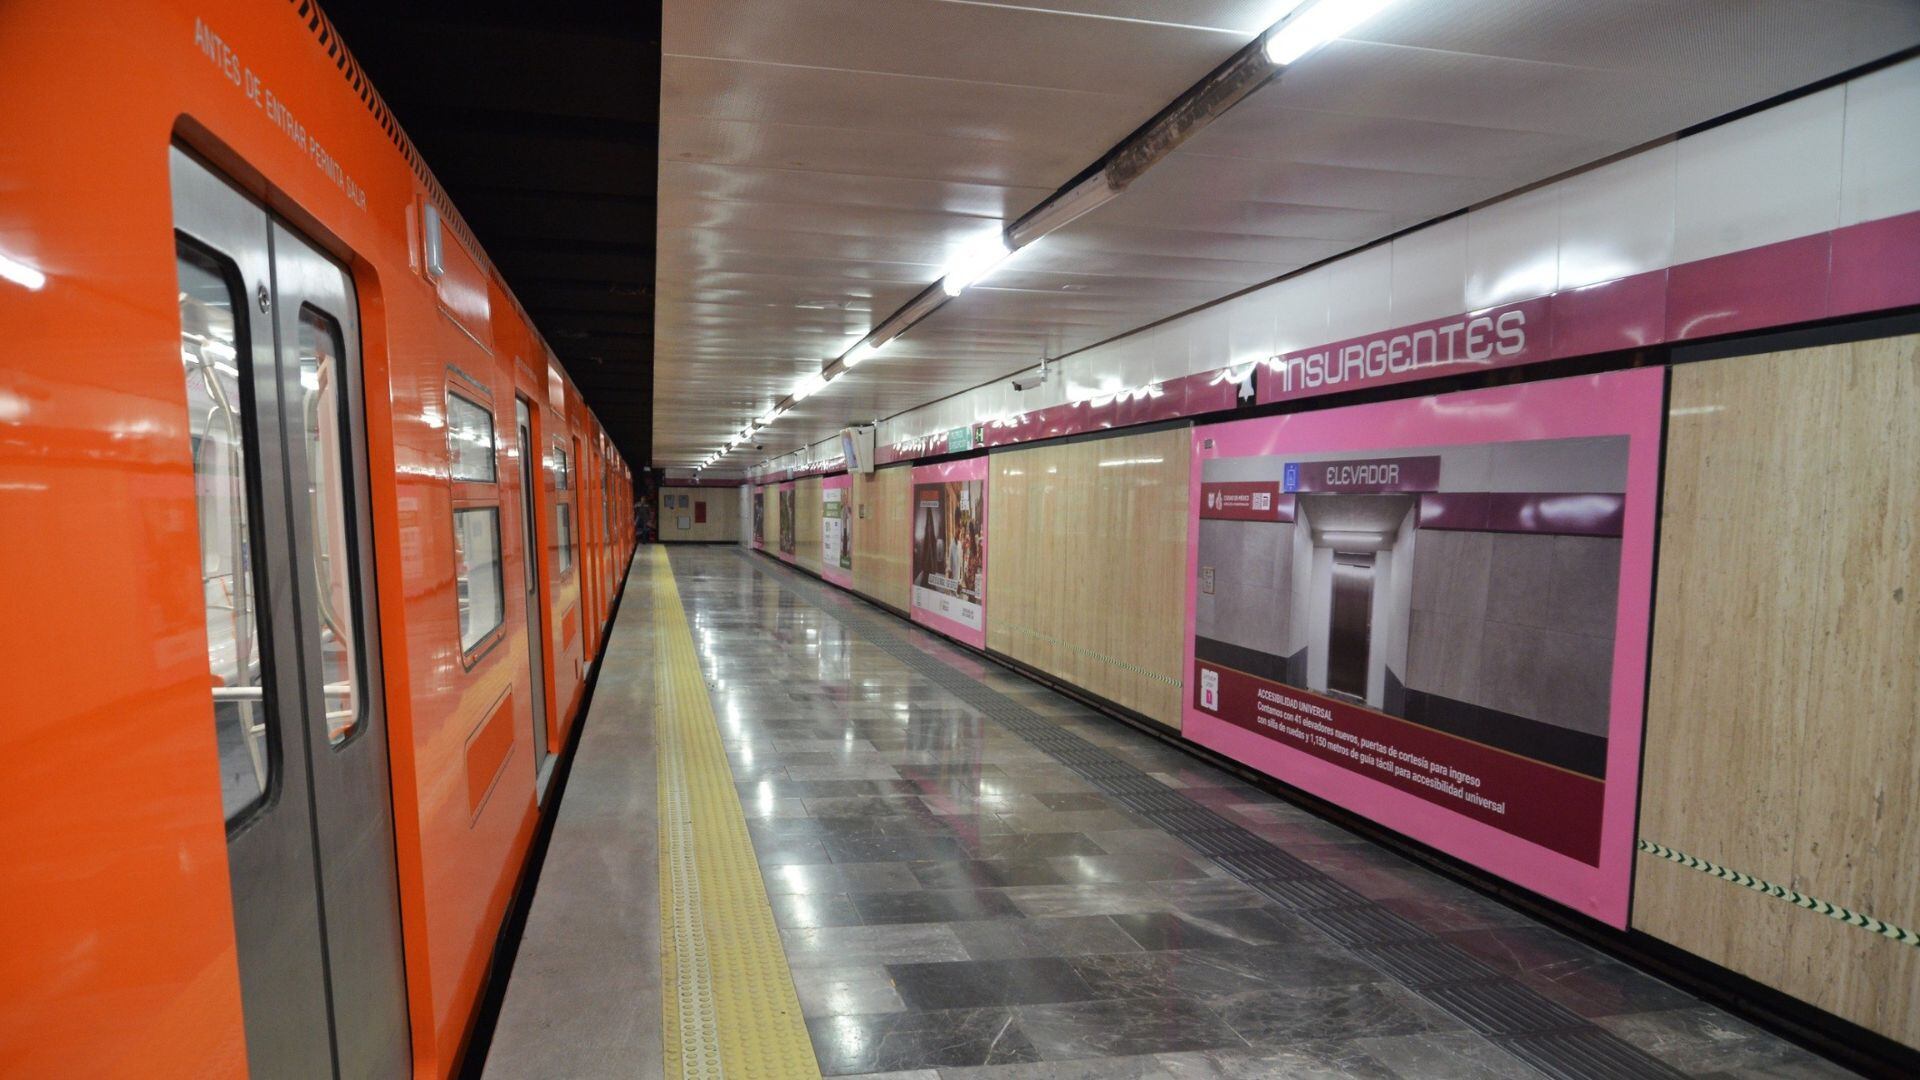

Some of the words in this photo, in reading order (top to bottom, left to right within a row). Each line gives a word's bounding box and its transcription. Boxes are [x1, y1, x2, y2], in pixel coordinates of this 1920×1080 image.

[194, 16, 241, 86] ANTES
[244, 66, 263, 110] DE
[265, 89, 307, 152] ENTRAR
[309, 135, 344, 190] PERMITA
[346, 175, 368, 213] SALIR
[1282, 310, 1526, 392] INSURGENTES
[1326, 464, 1399, 486] ELEVADOR
[1258, 688, 1298, 709] ACCESIBILIDAD
[1298, 701, 1333, 721] UNIVERSAL
[1258, 701, 1283, 717] Contamos
[1283, 710, 1294, 721] con
[1294, 714, 1302, 723] 41
[1302, 717, 1334, 736] elevadores
[1335, 729, 1360, 746] nuevos,
[1360, 738, 1387, 754] puertas
[1388, 745, 1398, 757] de
[1398, 750, 1429, 769] cortesía
[1430, 761, 1447, 776] para
[1450, 766, 1481, 787] ingreso
[1258, 715, 1267, 725] con
[1267, 718, 1278, 730] silla
[1278, 722, 1285, 732] de
[1286, 726, 1305, 740] ruedas
[1305, 733, 1309, 743] y
[1309, 733, 1327, 748] 1,150
[1327, 742, 1349, 756] metros
[1350, 748, 1359, 759] de
[1359, 752, 1375, 765] guía
[1376, 757, 1394, 772] táctil
[1394, 765, 1411, 779] para
[1412, 771, 1464, 799] accesibilidad
[1465, 791, 1505, 814] universal
